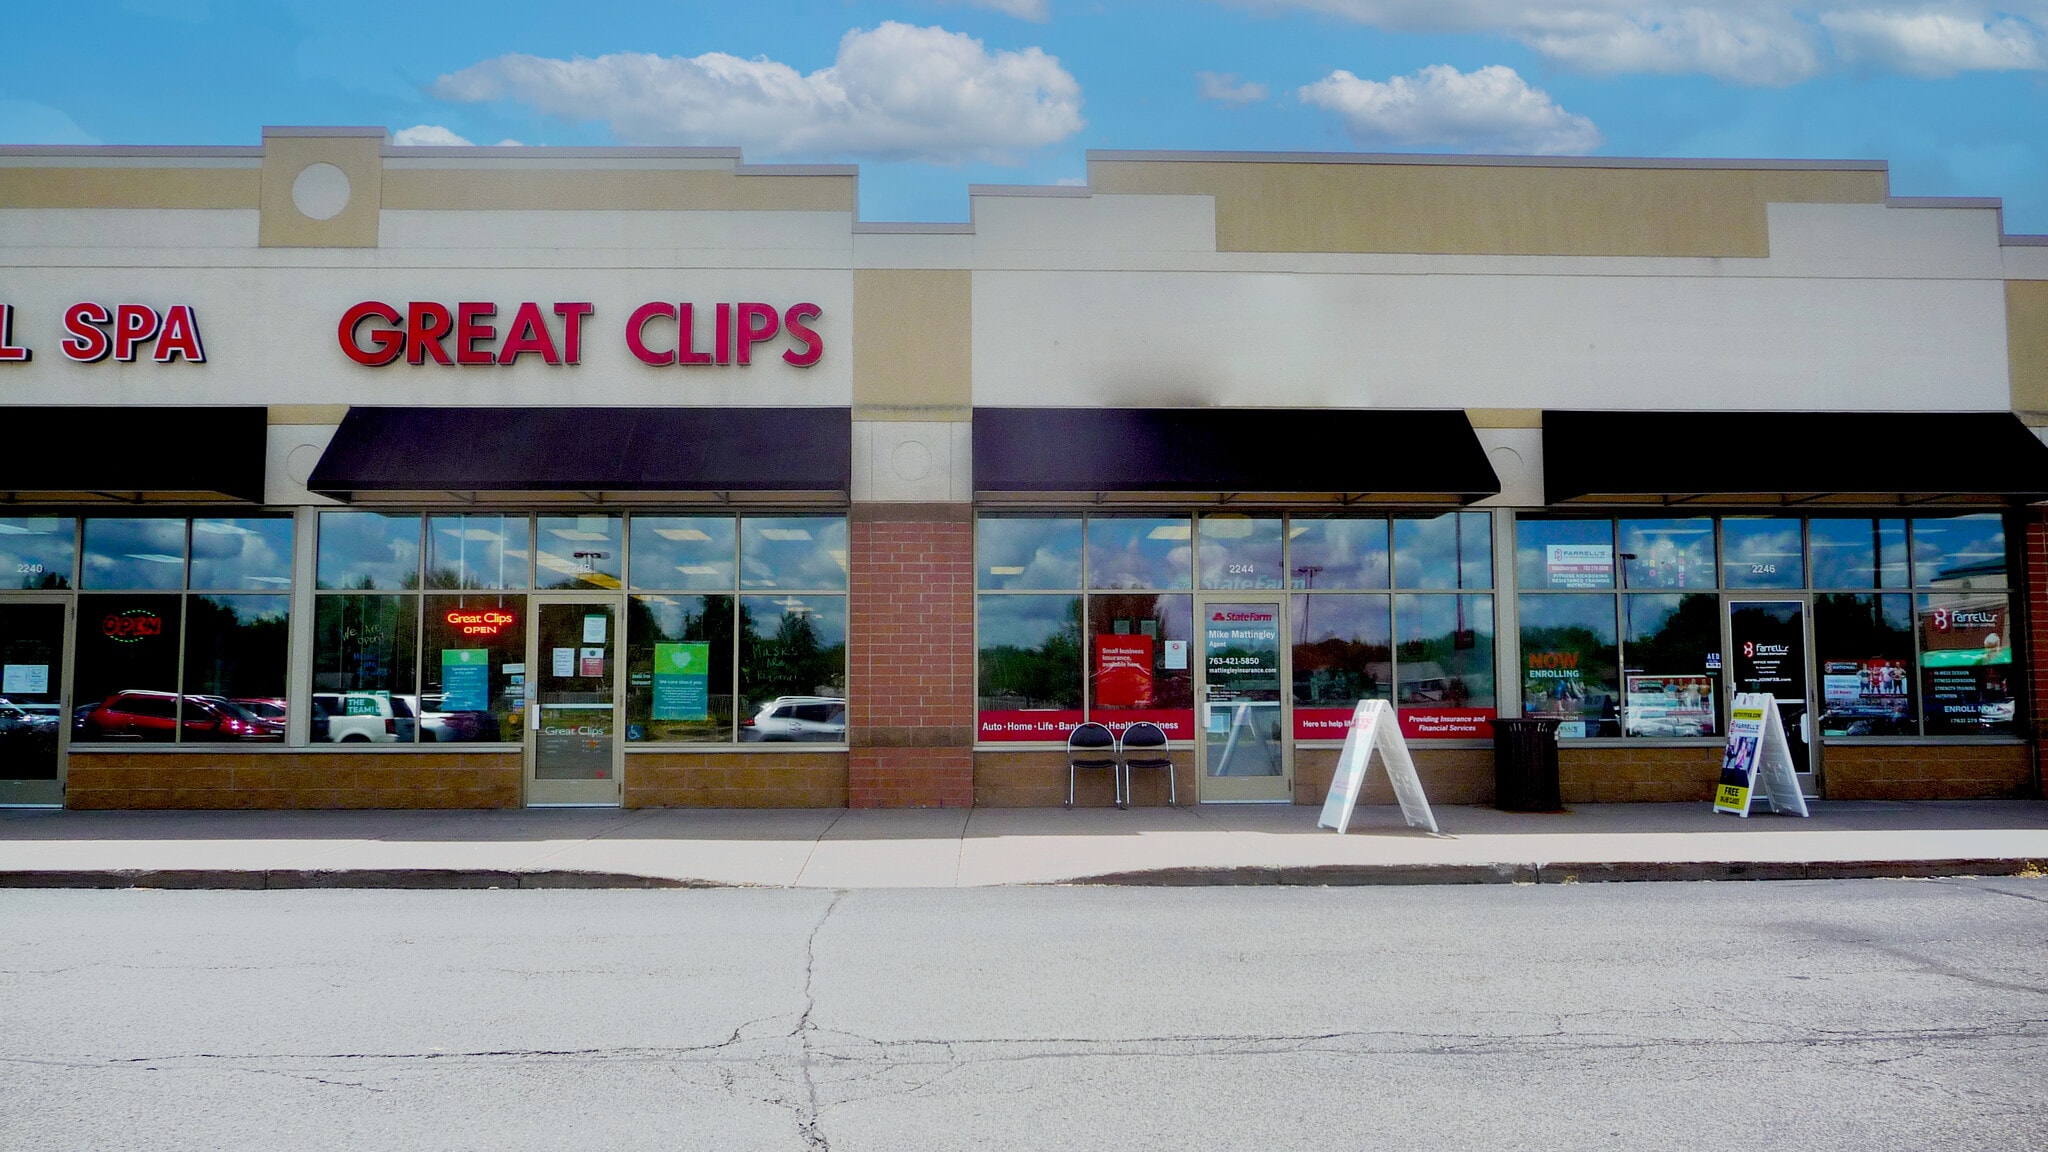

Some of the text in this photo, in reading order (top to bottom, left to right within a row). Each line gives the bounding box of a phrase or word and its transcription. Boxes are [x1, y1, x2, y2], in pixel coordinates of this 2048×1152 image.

[62, 302, 206, 363] SPA
[338, 301, 824, 367] GREAT CLIPS
[17, 564, 43, 573] 2240
[1229, 564, 1254, 574] 2244
[1751, 564, 1776, 574] 2246
[447, 613, 512, 625] Great Clips
[103, 615, 161, 635] OPEN
[463, 626, 497, 634] OPEN
[1209, 630, 1275, 640] Mike Mattingley
[1209, 657, 1259, 665] 763-421-5850
[1529, 652, 1579, 669] NOW
[1707, 652, 1720, 660] AED
[1209, 667, 1277, 675] mattingleyinsurance.com
[1529, 670, 1579, 678] ENROLLING
[1944, 705, 1976, 713] ENROLL
[1303, 720, 1319, 728] Here
[1320, 720, 1327, 728] to
[1328, 720, 1343, 730] help
[1409, 716, 1439, 724] Providing
[982, 721, 1002, 731] Auto
[1007, 721, 1032, 731] Home
[1038, 721, 1053, 731] Life
[545, 726, 604, 737] Great Clips
[1724, 786, 1740, 797] FREE
